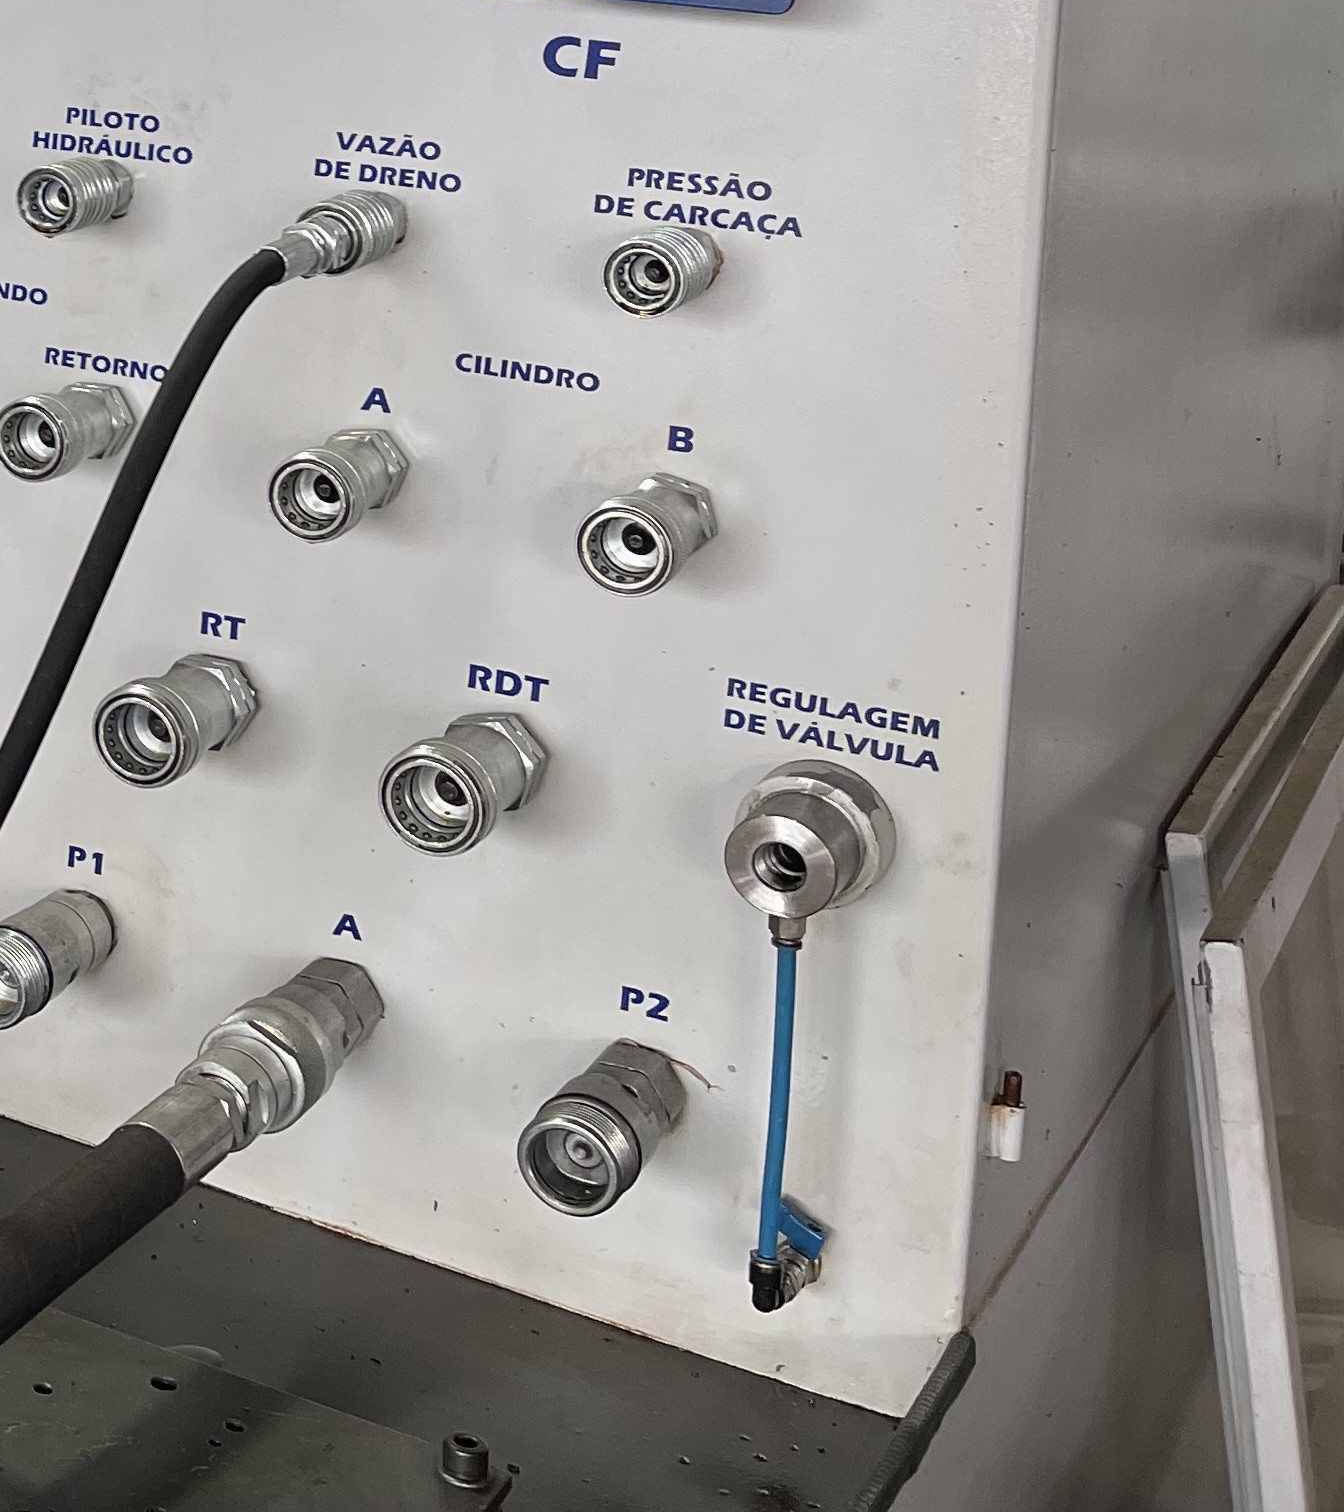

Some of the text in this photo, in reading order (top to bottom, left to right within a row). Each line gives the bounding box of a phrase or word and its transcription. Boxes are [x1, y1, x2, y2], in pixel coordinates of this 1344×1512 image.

[542, 36, 621, 80] CF
[65, 107, 160, 133] PILOTO
[32, 131, 192, 164] HIDRÁULICO
[336, 131, 441, 161] VAZÃO
[314, 159, 461, 193] DE DRENO
[627, 167, 772, 201] PRESSÃO
[594, 194, 802, 239] DE CARCAÇA
[45, 347, 169, 382] RETORNO
[455, 352, 601, 392] CILINDRO
[361, 387, 391, 414] A
[667, 425, 694, 454] B
[201, 611, 246, 642] RT
[467, 663, 550, 703] RDT
[726, 677, 941, 740] REGULAGEM
[723, 708, 940, 773] DE VÁLVULA
[67, 844, 105, 876] P1
[333, 914, 363, 941] A
[620, 986, 671, 1022] P2
